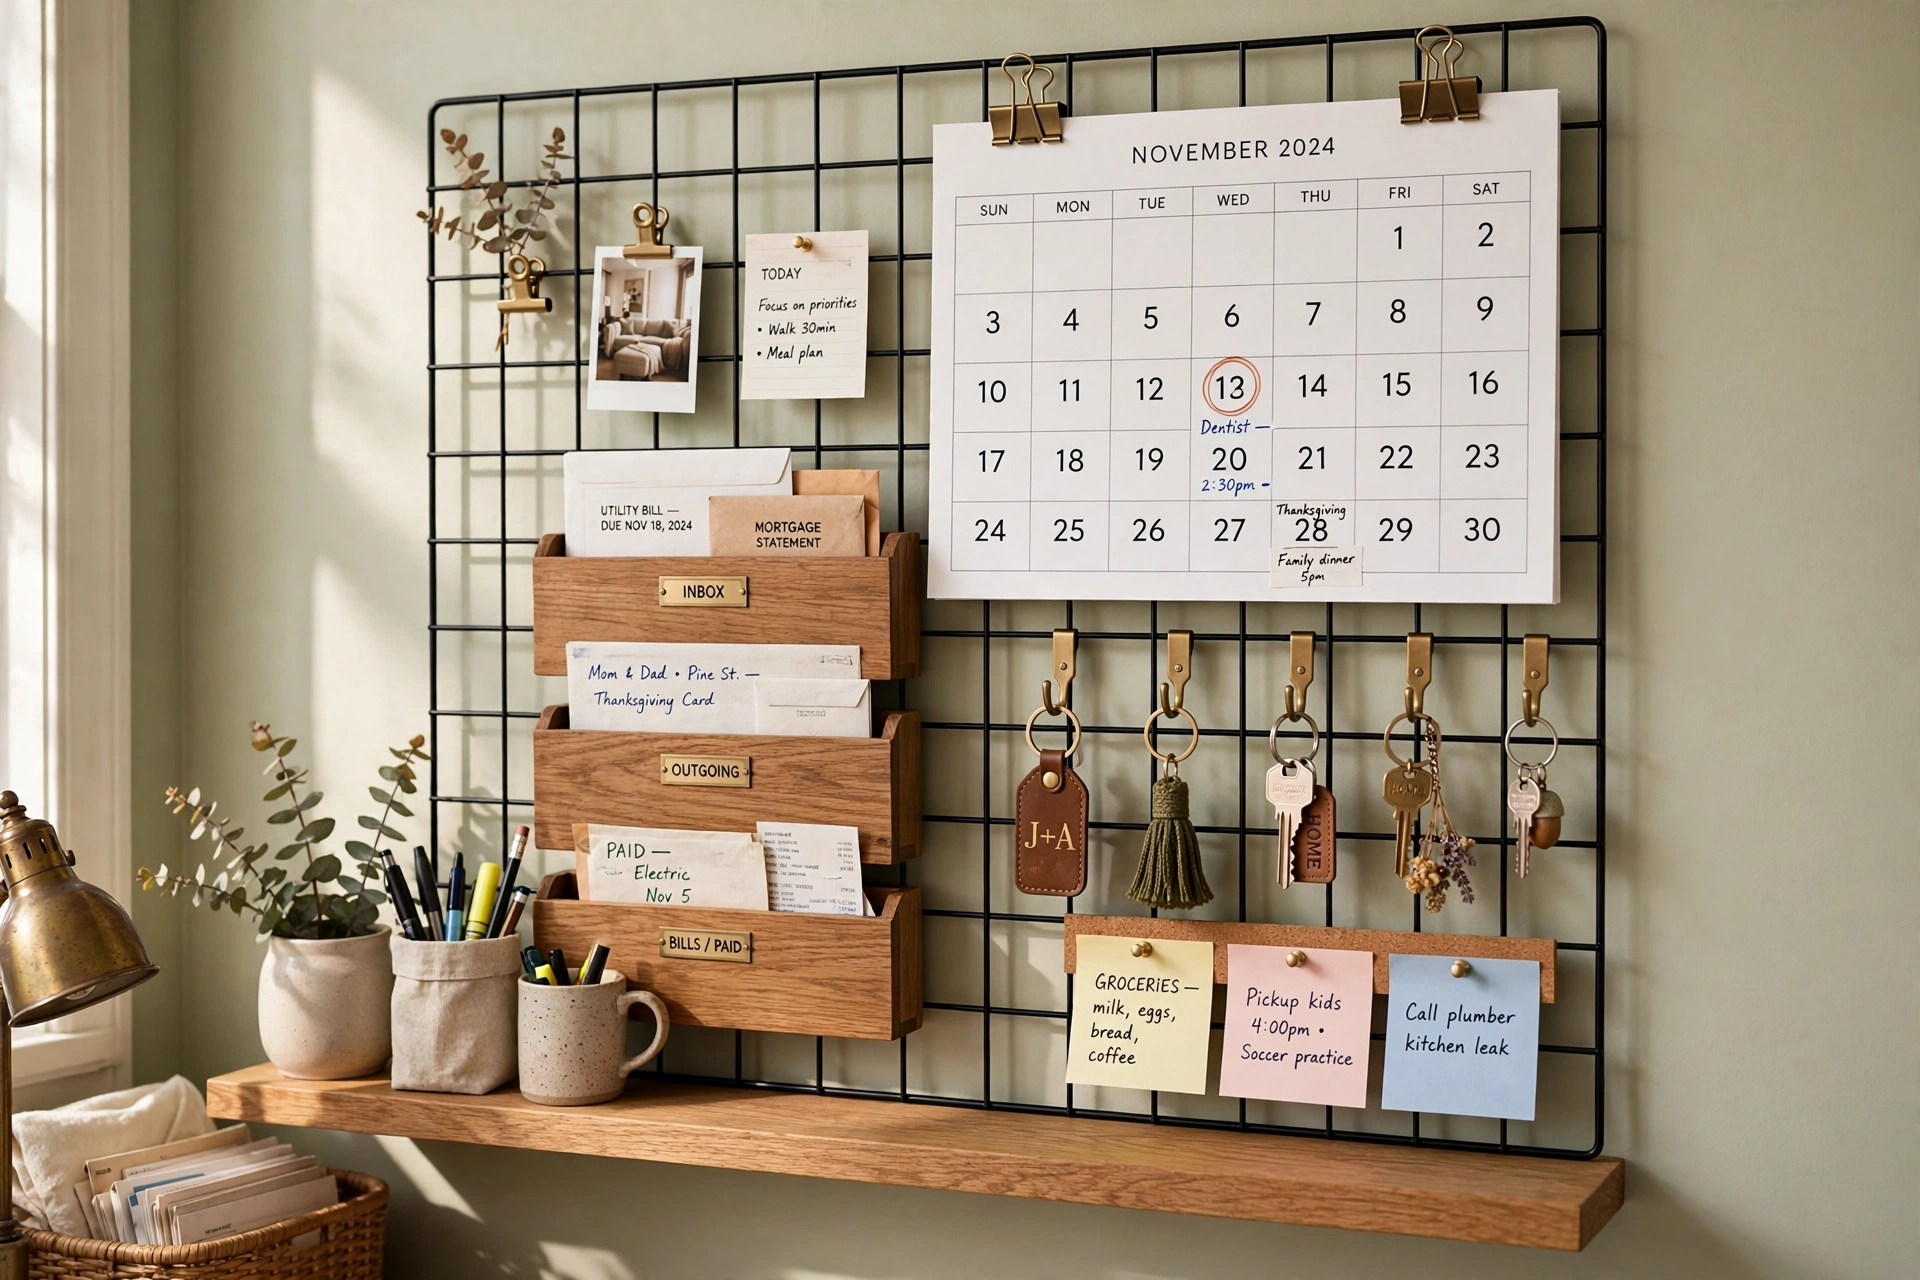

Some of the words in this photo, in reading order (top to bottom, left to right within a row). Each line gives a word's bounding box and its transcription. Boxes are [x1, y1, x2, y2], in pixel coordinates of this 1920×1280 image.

[1133, 141, 1267, 163] NOVEMBER
[1280, 137, 1334, 157] 2024
[981, 204, 1007, 216] SUN
[1057, 201, 1089, 213] MON
[1139, 197, 1165, 209] TUE
[1217, 194, 1249, 206] WED
[1301, 190, 1330, 202] THU
[1390, 187, 1410, 199] FRI
[1473, 183, 1499, 195] SAT
[1394, 226, 1401, 249] 1
[1478, 223, 1493, 246] 2
[762, 268, 801, 280] TODAY
[759, 298, 787, 311] Focus
[809, 296, 856, 315] priorities
[986, 311, 1000, 333] 3
[1063, 309, 1079, 331] 4
[1144, 306, 1158, 329] 5
[1225, 304, 1239, 327] 6
[1306, 302, 1321, 325] 7
[1390, 299, 1406, 323] 8
[1477, 296, 1493, 321] 9
[769, 322, 795, 335] Walk
[802, 322, 835, 334] 30min
[767, 345, 794, 359] Meal
[799, 345, 822, 364] plan
[979, 380, 1006, 403] 10
[1060, 379, 1079, 401] 11
[1137, 377, 1163, 400] 12
[1216, 376, 1248, 405] 13
[1299, 374, 1327, 397] 14
[1383, 372, 1410, 396] 15
[1469, 371, 1498, 394] 16
[1200, 418, 1251, 437] Dentist
[979, 450, 1005, 472] 17
[1057, 449, 1083, 472] 18
[1136, 448, 1163, 471] 19
[1213, 448, 1246, 471] 20
[1299, 446, 1324, 469] 21
[1380, 445, 1412, 469] 22
[1466, 444, 1499, 468] 23
[1202, 479, 1255, 497] 2:30pm
[601, 506, 638, 515] UTILITY
[642, 505, 663, 515] BILL
[1275, 502, 1347, 521] Thanksgiving
[602, 521, 621, 530] DUE
[626, 520, 647, 530] NOV
[651, 520, 664, 532] 18,
[669, 520, 692, 530] 2024
[755, 521, 821, 533] MORTGAGE
[975, 519, 1006, 541] 24
[1054, 519, 1084, 541] 25
[1133, 519, 1164, 541] 26
[1215, 519, 1245, 541] 27
[1296, 518, 1327, 541] 28
[1379, 518, 1412, 541] 29
[1465, 518, 1500, 541] 30
[757, 537, 821, 548] STATEMENT
[1276, 552, 1315, 570] Family
[1320, 554, 1355, 565] dinner
[1300, 570, 1326, 587] 5pm
[684, 585, 724, 598] INBOX
[589, 665, 617, 679] Mom
[641, 665, 666, 680] Dad
[688, 665, 714, 680] Pine
[721, 667, 738, 680] St.
[683, 692, 714, 706] Card
[671, 763, 740, 779] OUTGOING
[1024, 821, 1077, 850] J+A
[1306, 813, 1322, 870] HOME
[608, 842, 645, 858] PAID
[635, 864, 690, 880] Electric
[646, 887, 672, 902] Nov
[682, 889, 691, 903] 5
[670, 936, 700, 950] BILLS
[705, 937, 710, 952] /
[714, 939, 742, 954] PAID
[1247, 988, 1298, 1013] Pickup
[1309, 992, 1341, 1010] kids
[1093, 999, 1129, 1019] milk,
[1139, 1007, 1175, 1024] eggs,
[1406, 1002, 1437, 1021] Call
[1447, 1004, 1515, 1029] plumber
[1091, 1022, 1138, 1044] bread,
[1252, 1018, 1309, 1041] 4:00pm
[1406, 1028, 1464, 1053] kitchen
[1475, 1036, 1509, 1055] leak
[1089, 1047, 1135, 1064] coffee
[1241, 1044, 1288, 1061] Soccer
[1295, 1050, 1352, 1069] practice
